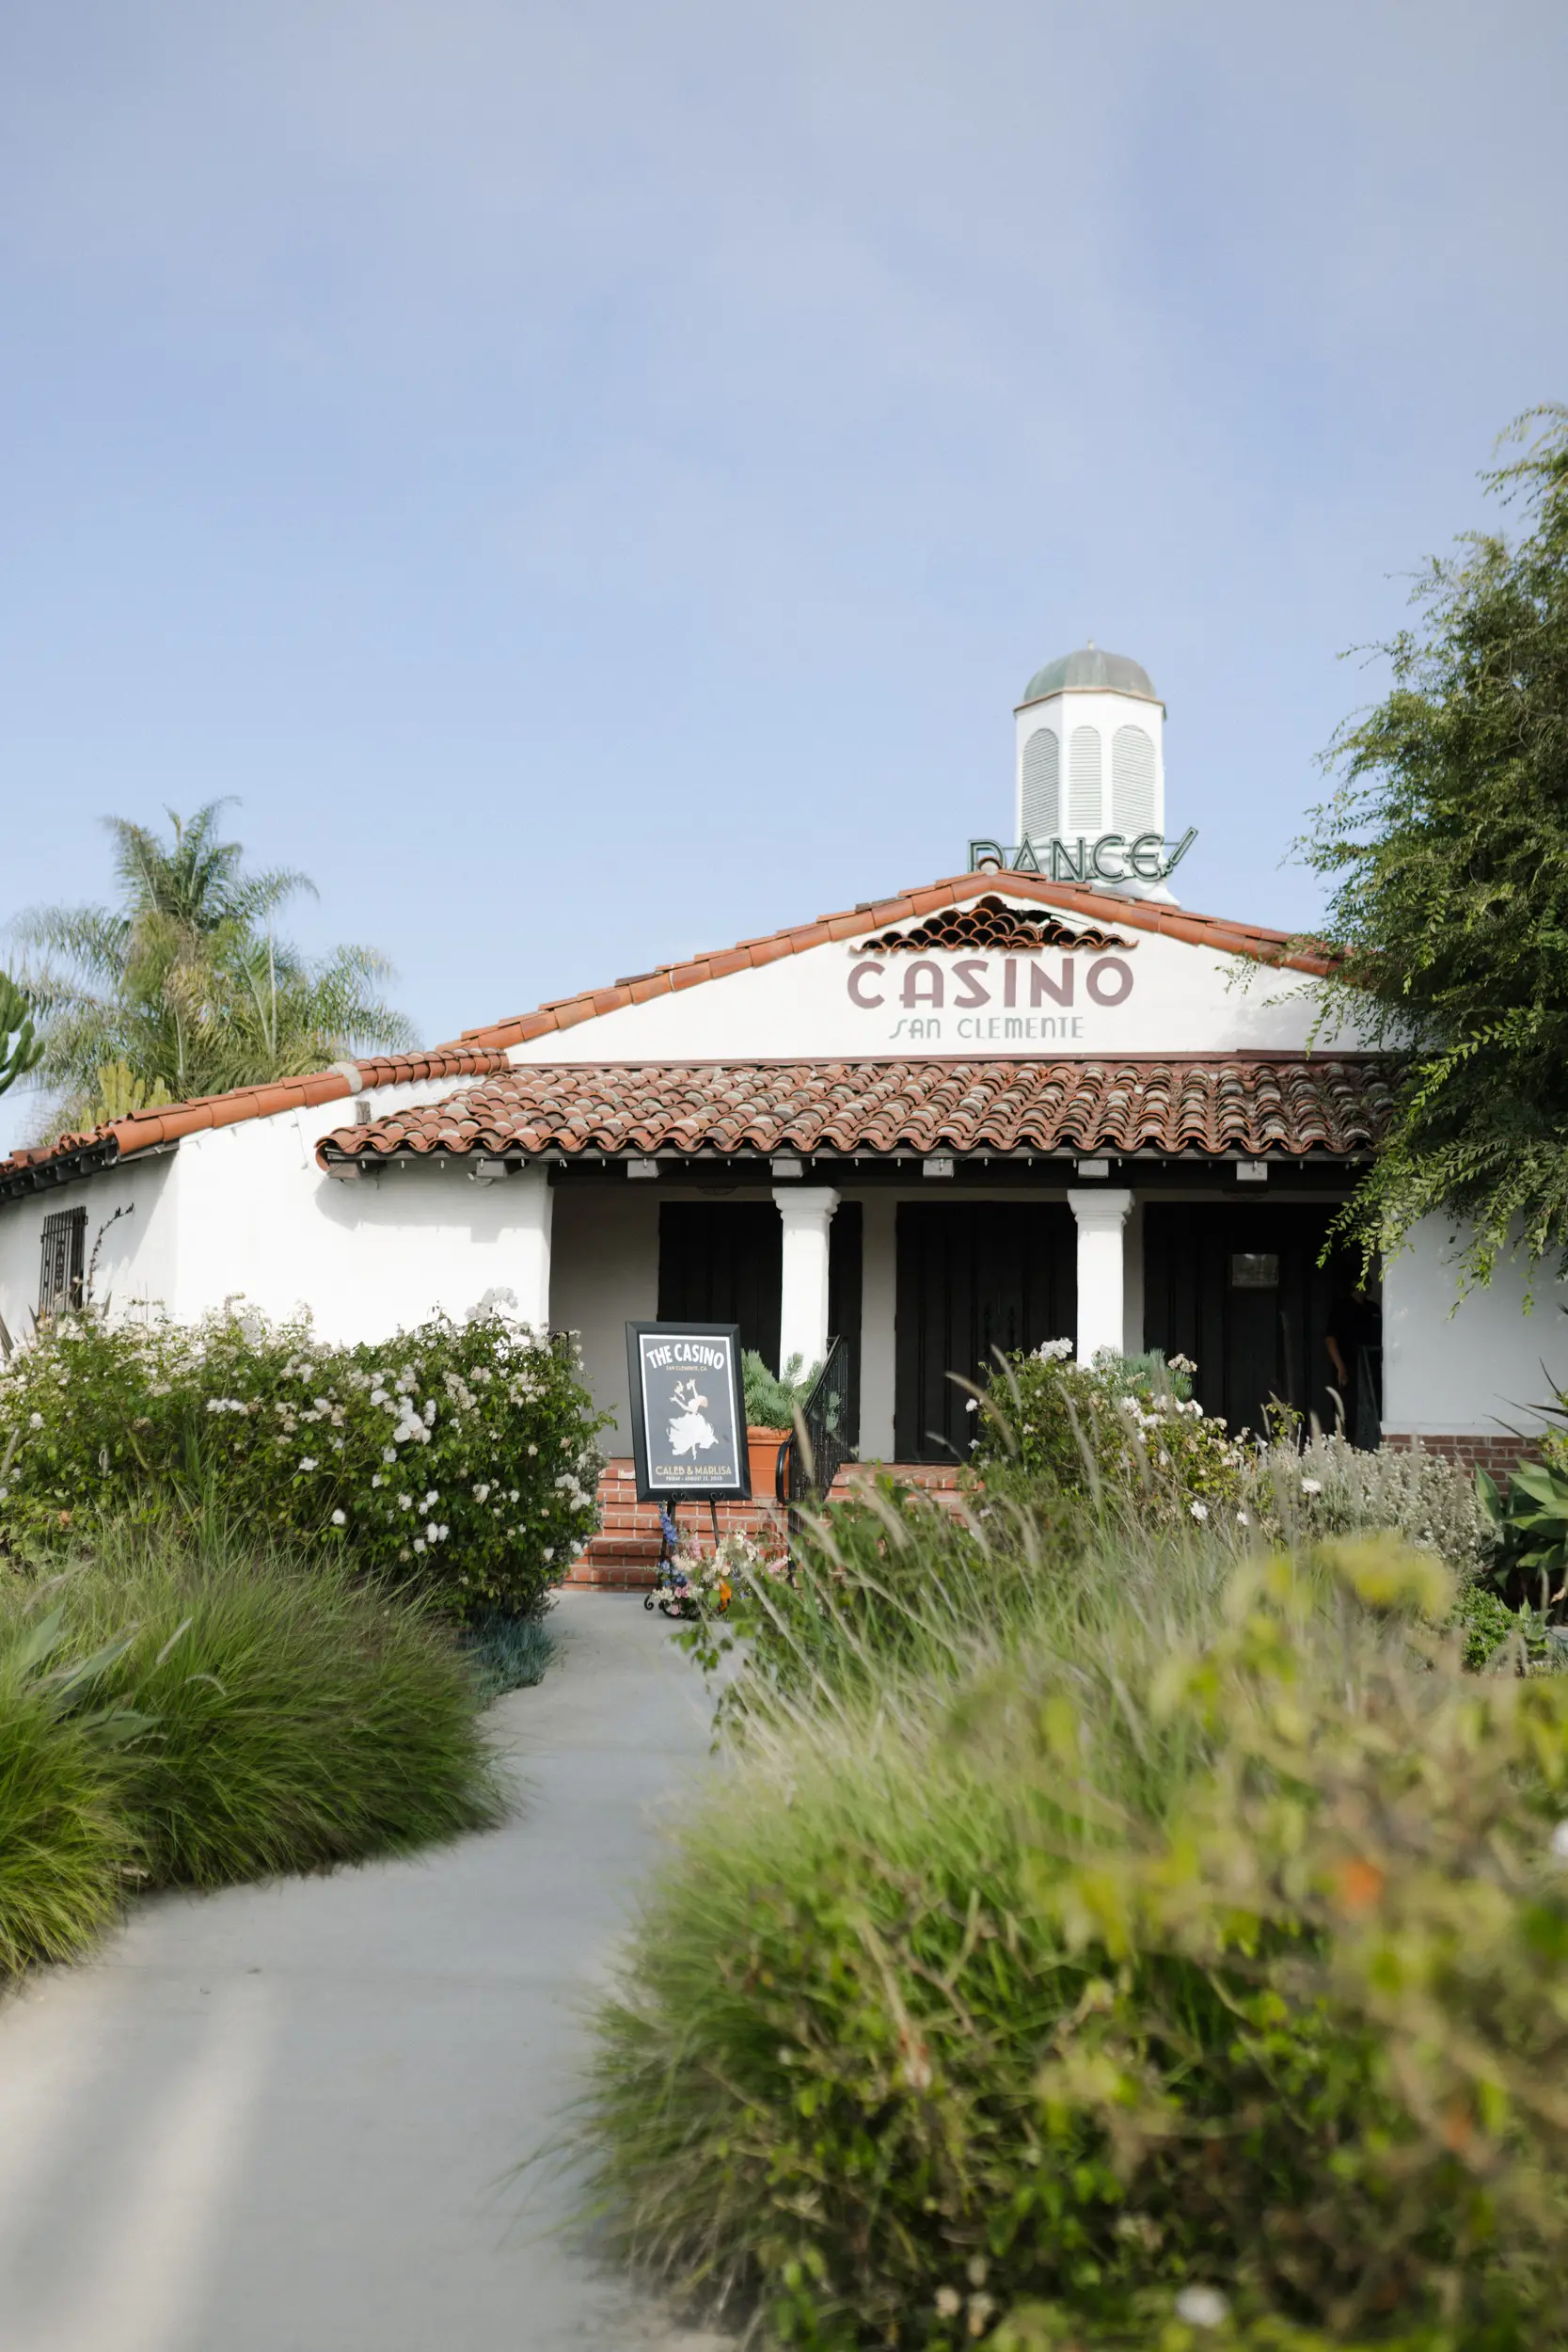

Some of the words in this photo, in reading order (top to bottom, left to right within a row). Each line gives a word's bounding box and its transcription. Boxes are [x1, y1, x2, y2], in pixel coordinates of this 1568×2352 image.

[968, 827, 1198, 883] DANCE!
[847, 957, 1134, 1009] CASINO
[888, 1017, 942, 1041] SAN
[957, 1016, 1085, 1040] CLEMENTE
[645, 1344, 673, 1369] THE
[673, 1343, 725, 1370] CASINO
[655, 1465, 685, 1476] CALEB
[687, 1465, 693, 1476] &
[694, 1465, 733, 1476] MARLISA
